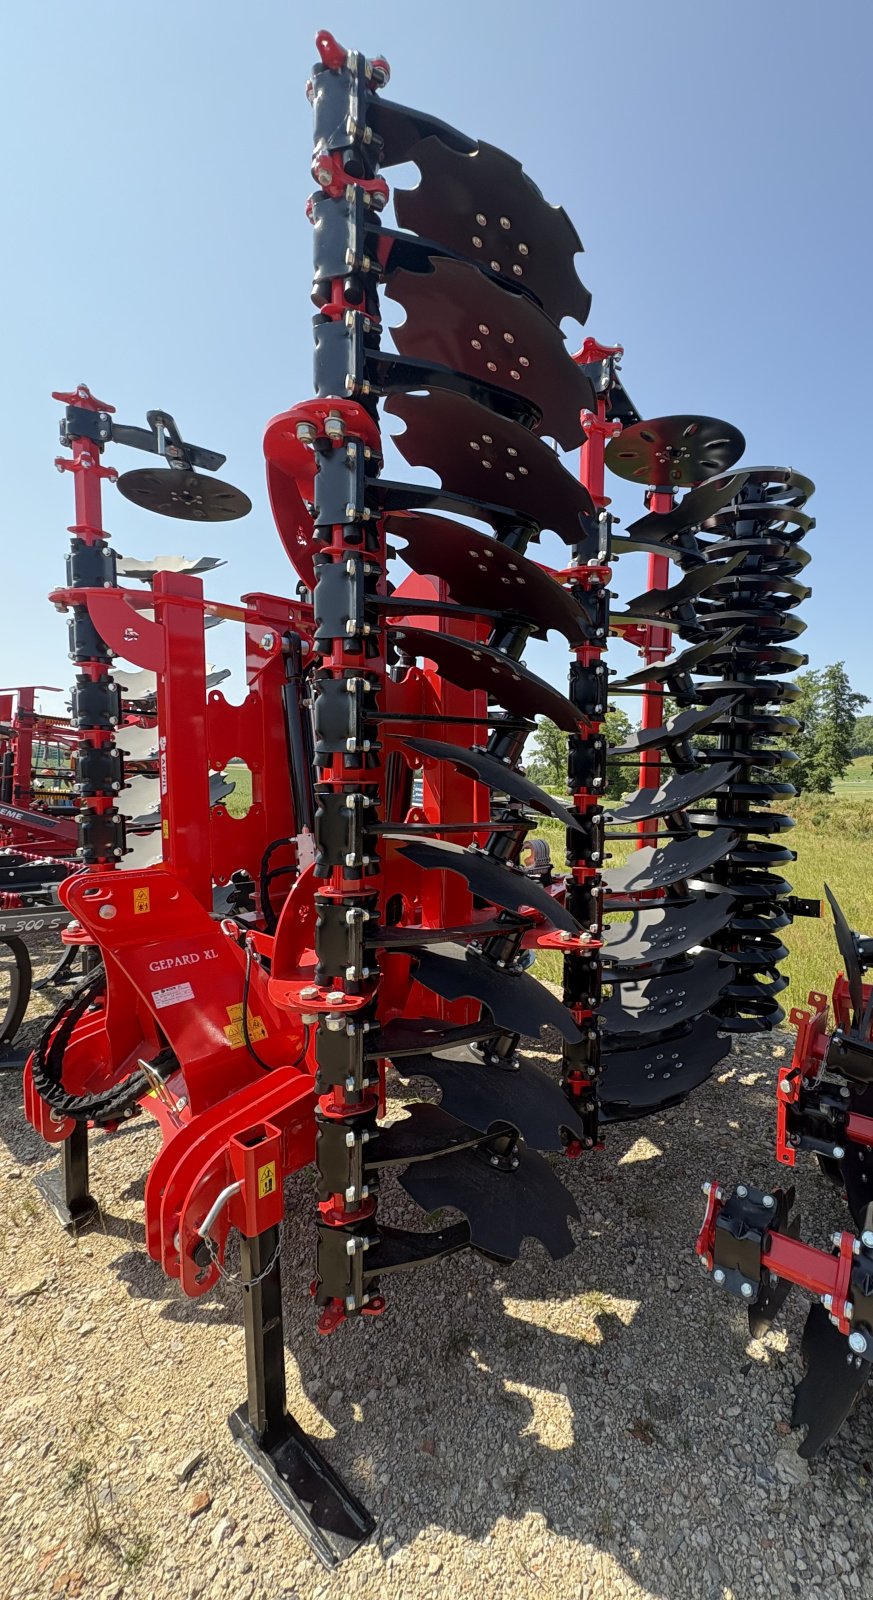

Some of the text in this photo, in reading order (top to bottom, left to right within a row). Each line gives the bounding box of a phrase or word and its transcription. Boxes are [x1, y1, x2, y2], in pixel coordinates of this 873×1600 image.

[13, 919, 45, 932] 300
[48, 918, 61, 929] S
[149, 949, 219, 972] GEPARD XL
